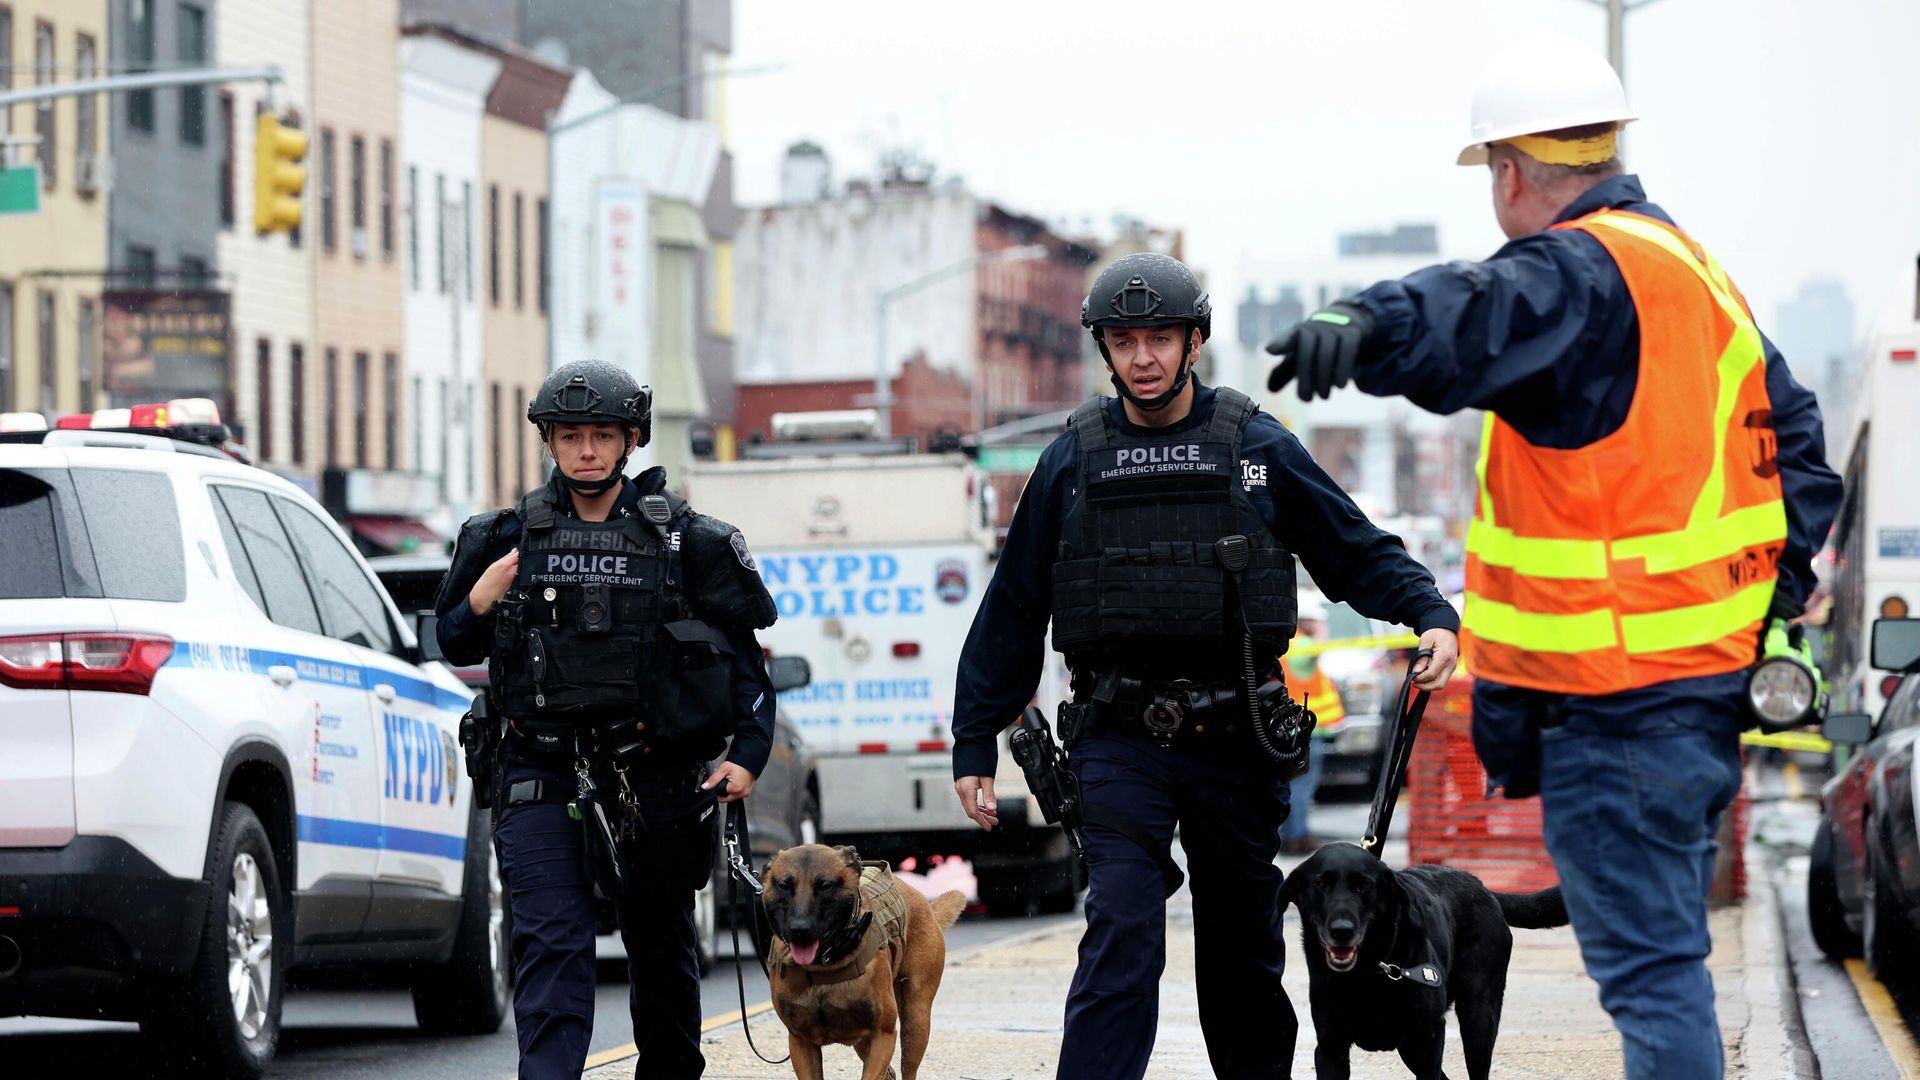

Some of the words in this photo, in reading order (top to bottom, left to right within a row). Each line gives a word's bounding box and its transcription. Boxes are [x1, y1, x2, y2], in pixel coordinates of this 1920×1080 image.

[1116, 444, 1200, 467] POLICE
[1101, 464, 1155, 479] EMERGENCY
[1157, 462, 1194, 472] SERVICE
[1196, 463, 1217, 472] UNIT
[1241, 465, 1267, 480] ICE
[547, 554, 628, 575] POLICE
[761, 554, 899, 585] NYPD
[584, 574, 620, 584] SERVICE
[621, 576, 643, 586] UNIT
[774, 586, 925, 618] OLICE
[855, 678, 931, 701] SERVICE
[383, 711, 443, 805] NYPD
